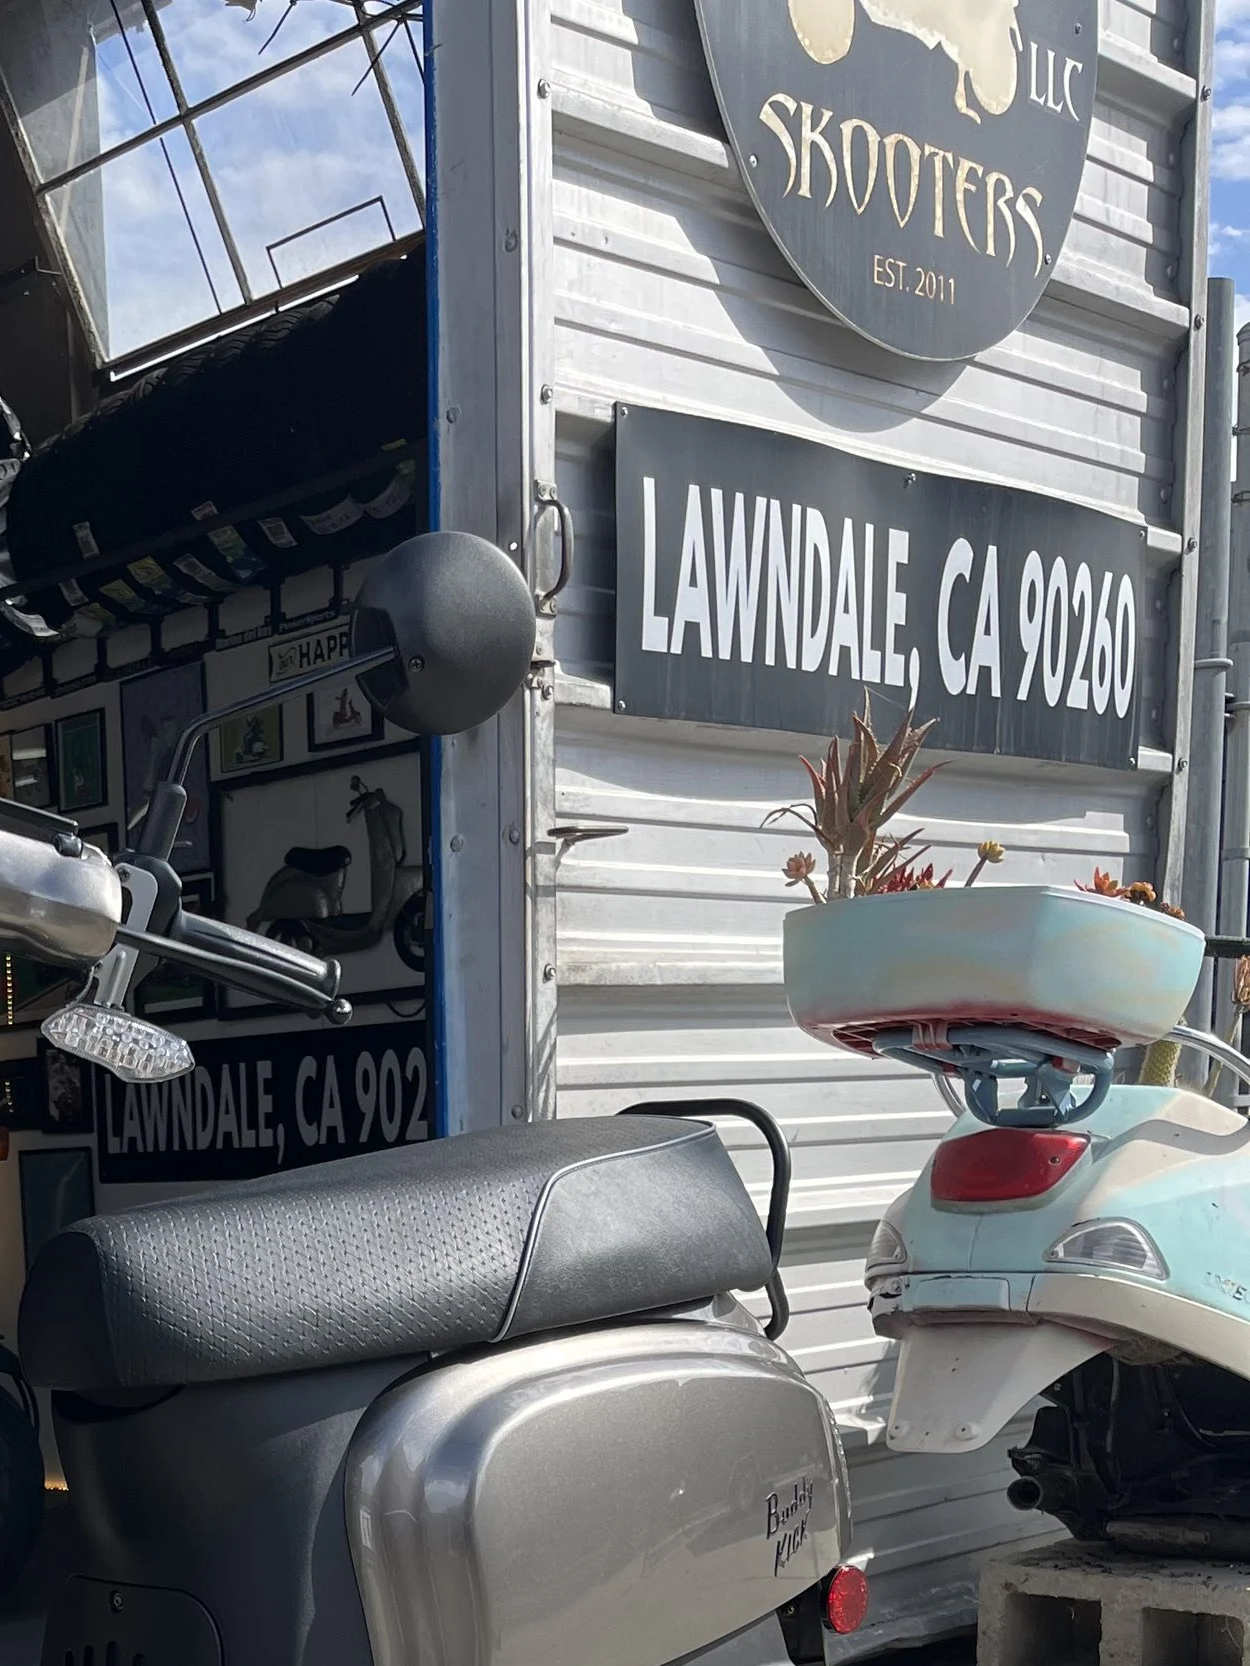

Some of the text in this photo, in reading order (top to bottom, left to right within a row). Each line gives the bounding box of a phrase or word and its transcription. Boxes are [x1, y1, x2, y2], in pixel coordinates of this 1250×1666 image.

[1028, 41, 1083, 121] LLC
[758, 92, 1044, 279] SKOOTERS
[873, 254, 955, 305] EST. 2011
[641, 476, 1137, 719] LAWNDALE, CA 90260
[104, 1047, 428, 1165] LAWNDALE, CA 902
[764, 1474, 813, 1539] Buddy
[773, 1518, 808, 1577] KICK
